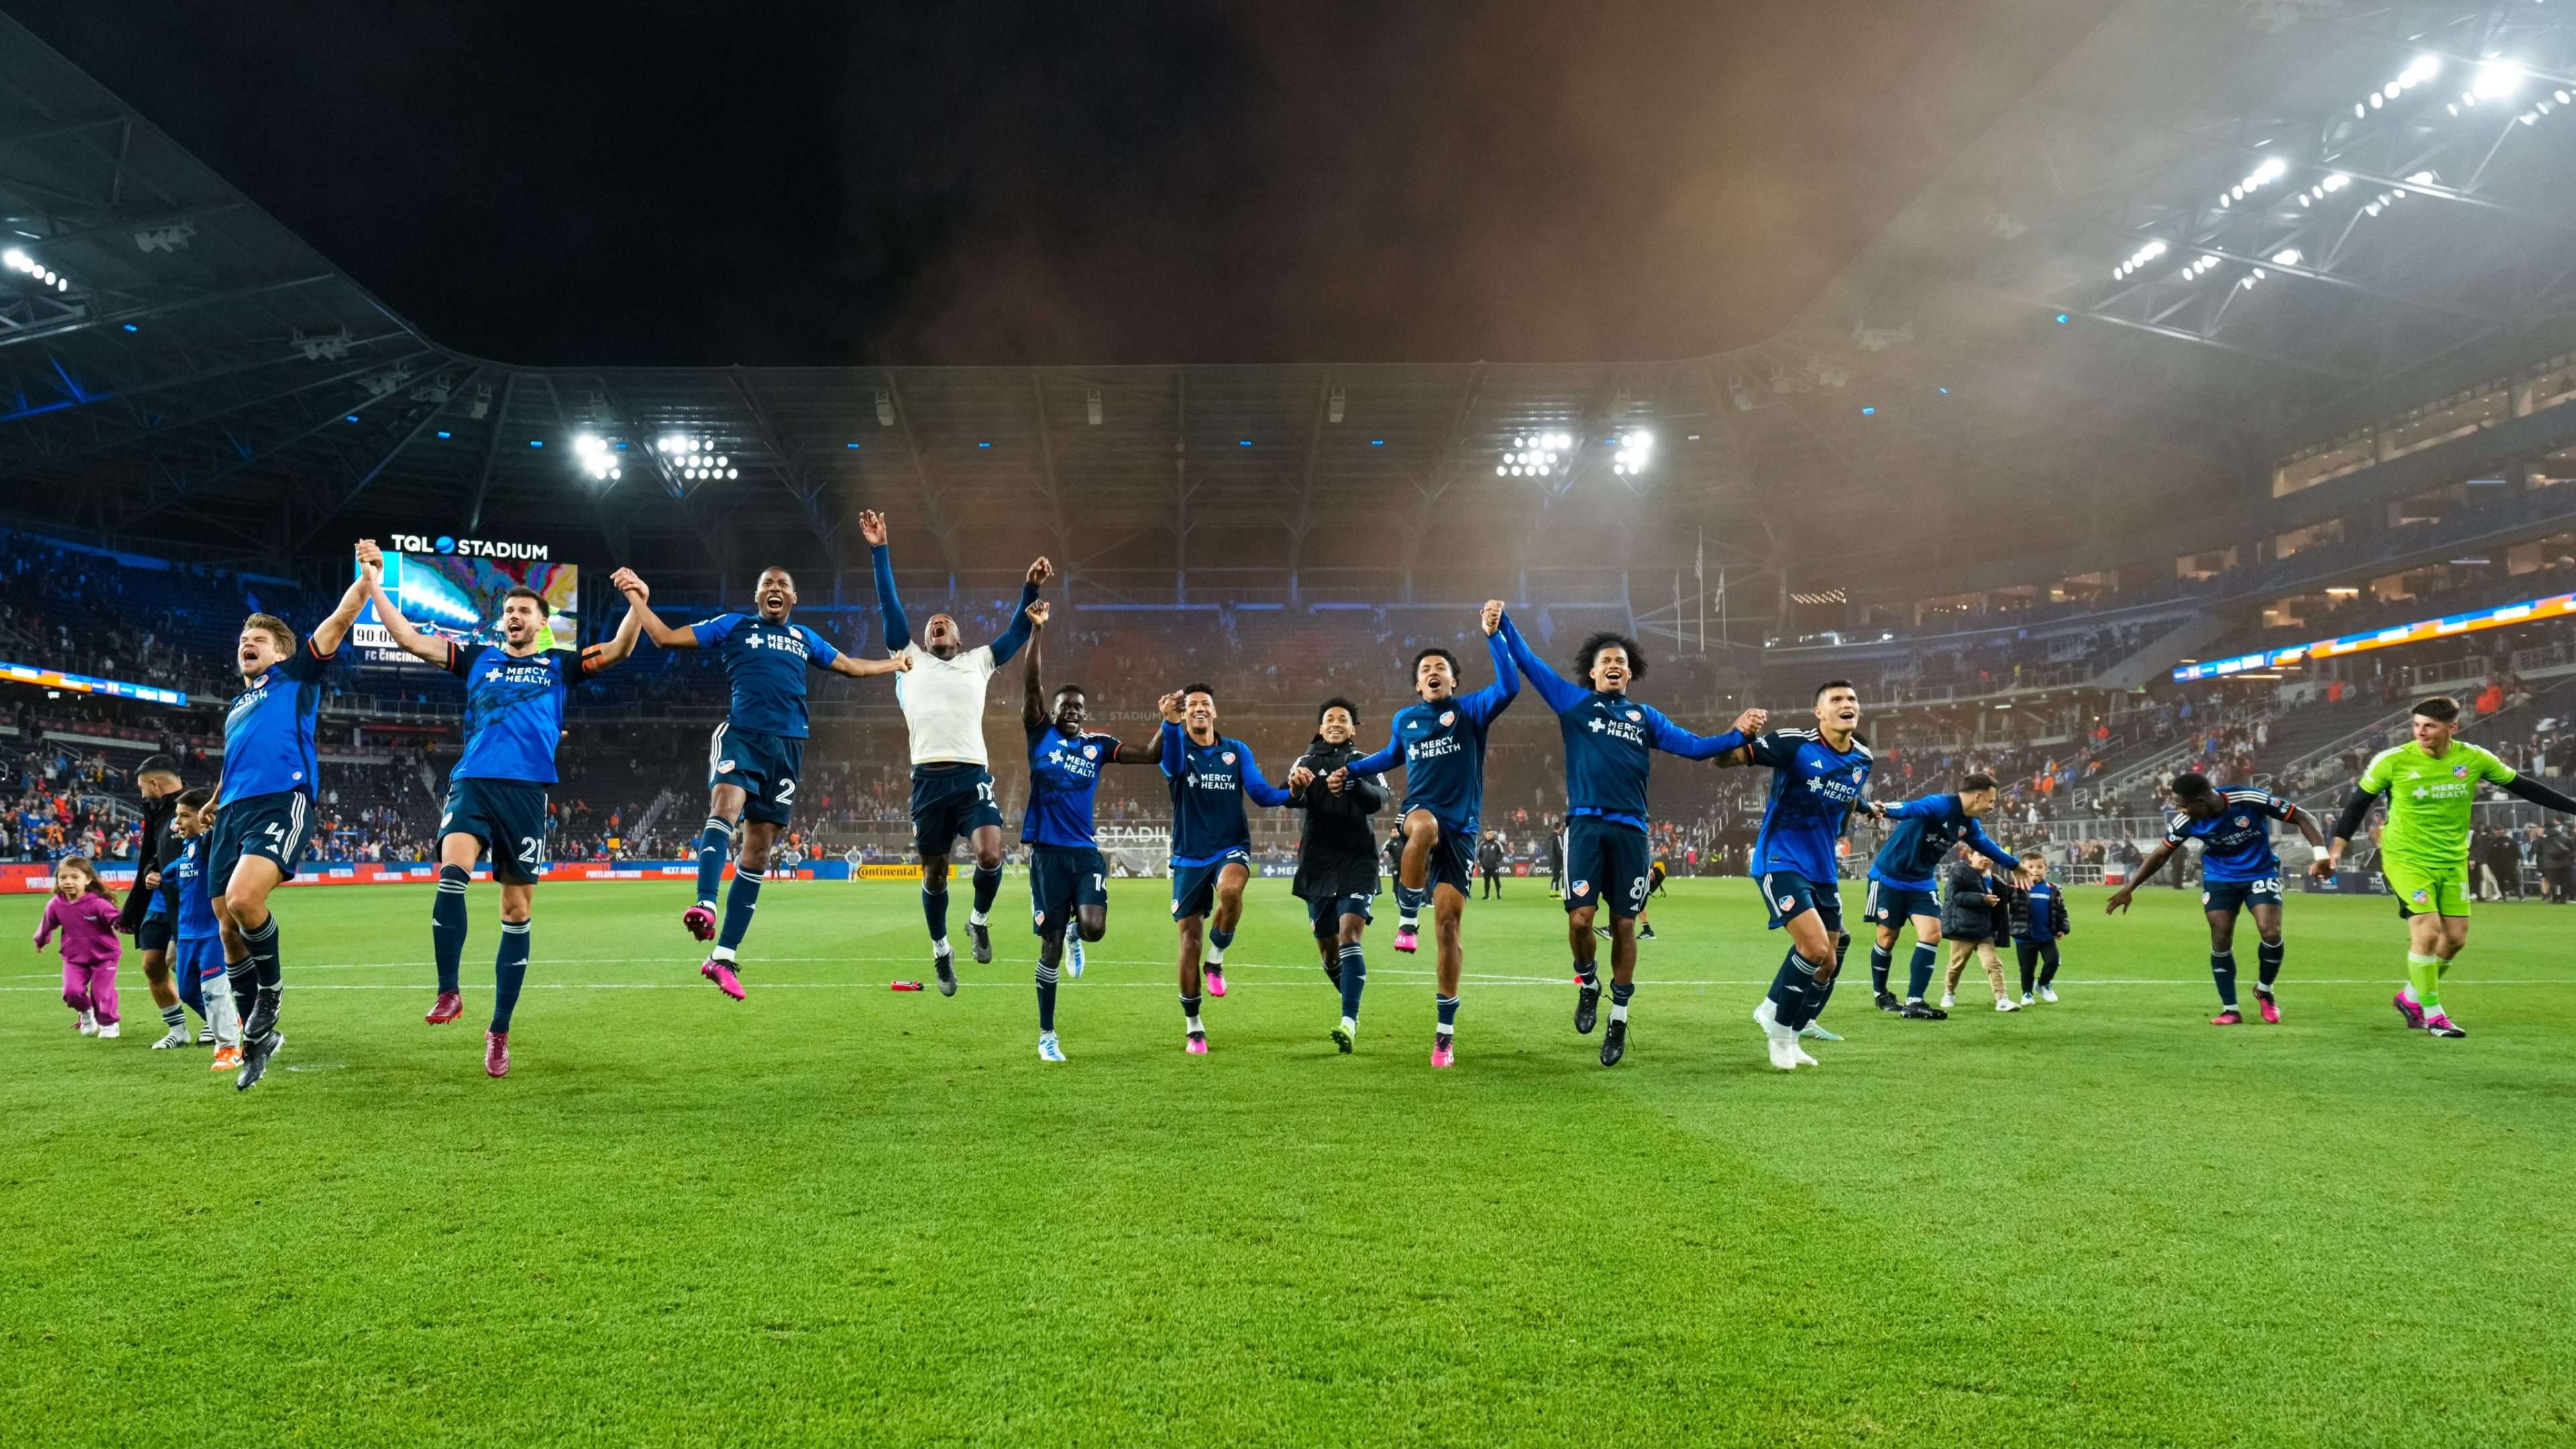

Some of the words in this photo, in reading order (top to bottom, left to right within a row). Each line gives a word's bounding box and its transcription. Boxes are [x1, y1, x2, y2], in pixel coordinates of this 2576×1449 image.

[392, 535, 434, 553] TQL
[458, 539, 548, 560] STADIUM
[767, 634, 804, 650] MERCY
[365, 650, 377, 661] FC
[379, 649, 425, 663] CINCINN
[767, 642, 808, 660] HEALTH
[506, 667, 547, 676] MERCY
[505, 676, 551, 687] HEALTH
[1110, 711, 1161, 721] STADIUM
[1608, 719, 1643, 735] MERCY
[1421, 735, 1454, 750] MERCY
[1421, 743, 1460, 759] HEALTH
[1066, 754, 1095, 769] MERCY
[1201, 774, 1232, 782] MERCY
[1201, 782, 1235, 790] HEALTH
[775, 778, 796, 805] 2
[1826, 780, 1856, 796] MERCY
[2432, 783, 2467, 792] MERCY
[264, 822, 285, 843] 4
[1096, 826, 1173, 843] STADIU
[518, 837, 543, 864] 21
[663, 866, 680, 875] NEXT
[680, 866, 698, 875] MATC
[857, 865, 917, 879] Continental
[1630, 877, 1645, 899] 8
[2253, 878, 2280, 894] 26
